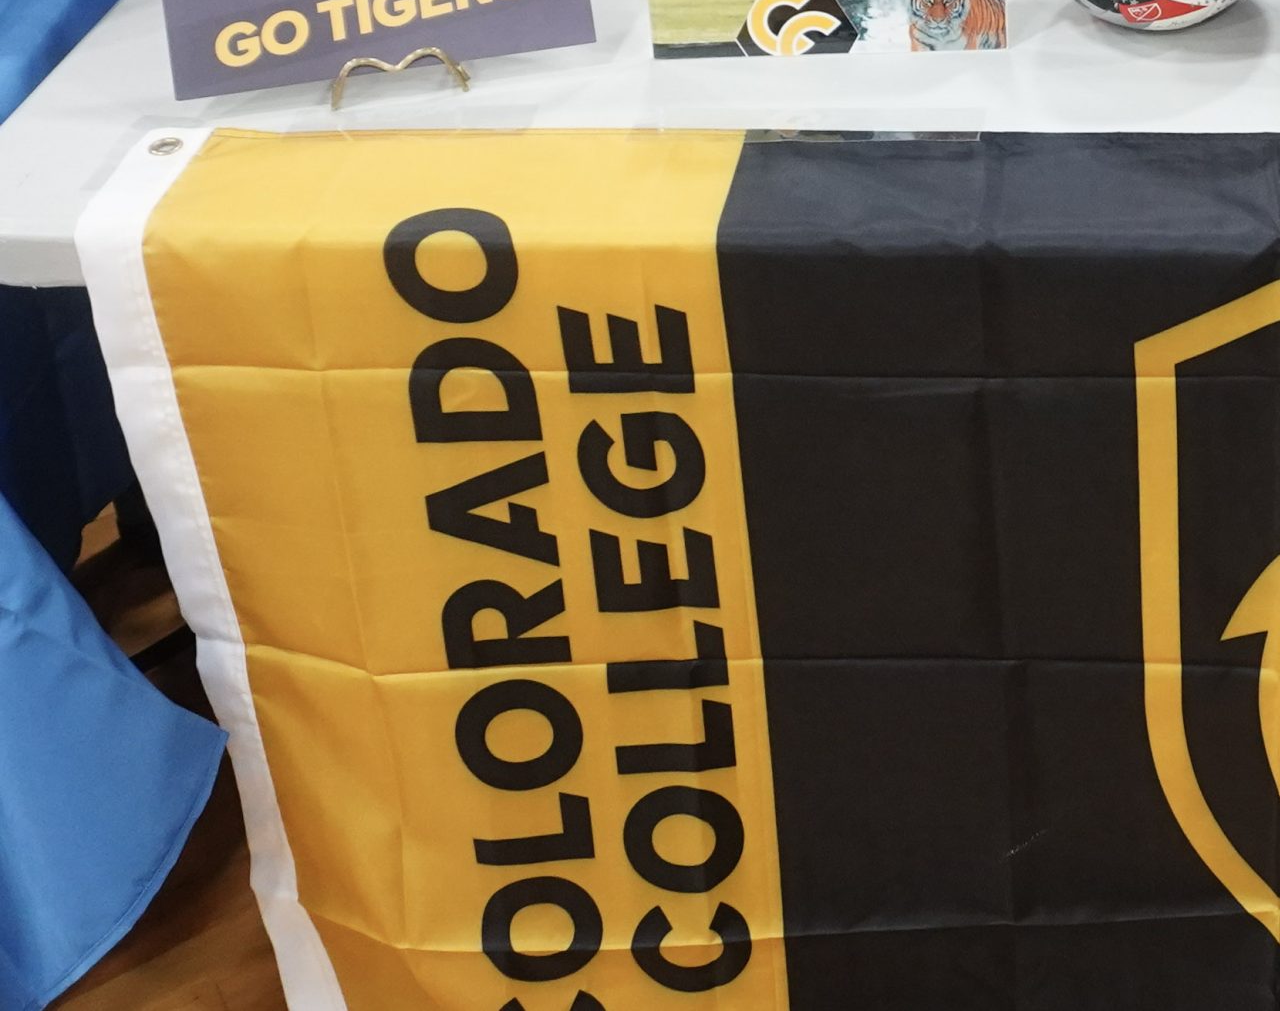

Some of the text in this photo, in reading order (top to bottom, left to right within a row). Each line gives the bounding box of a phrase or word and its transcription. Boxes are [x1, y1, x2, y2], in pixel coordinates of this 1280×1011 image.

[214, 9, 310, 68] GO
[383, 206, 607, 1011] OLORADO
[556, 303, 753, 993] COLLEGE
